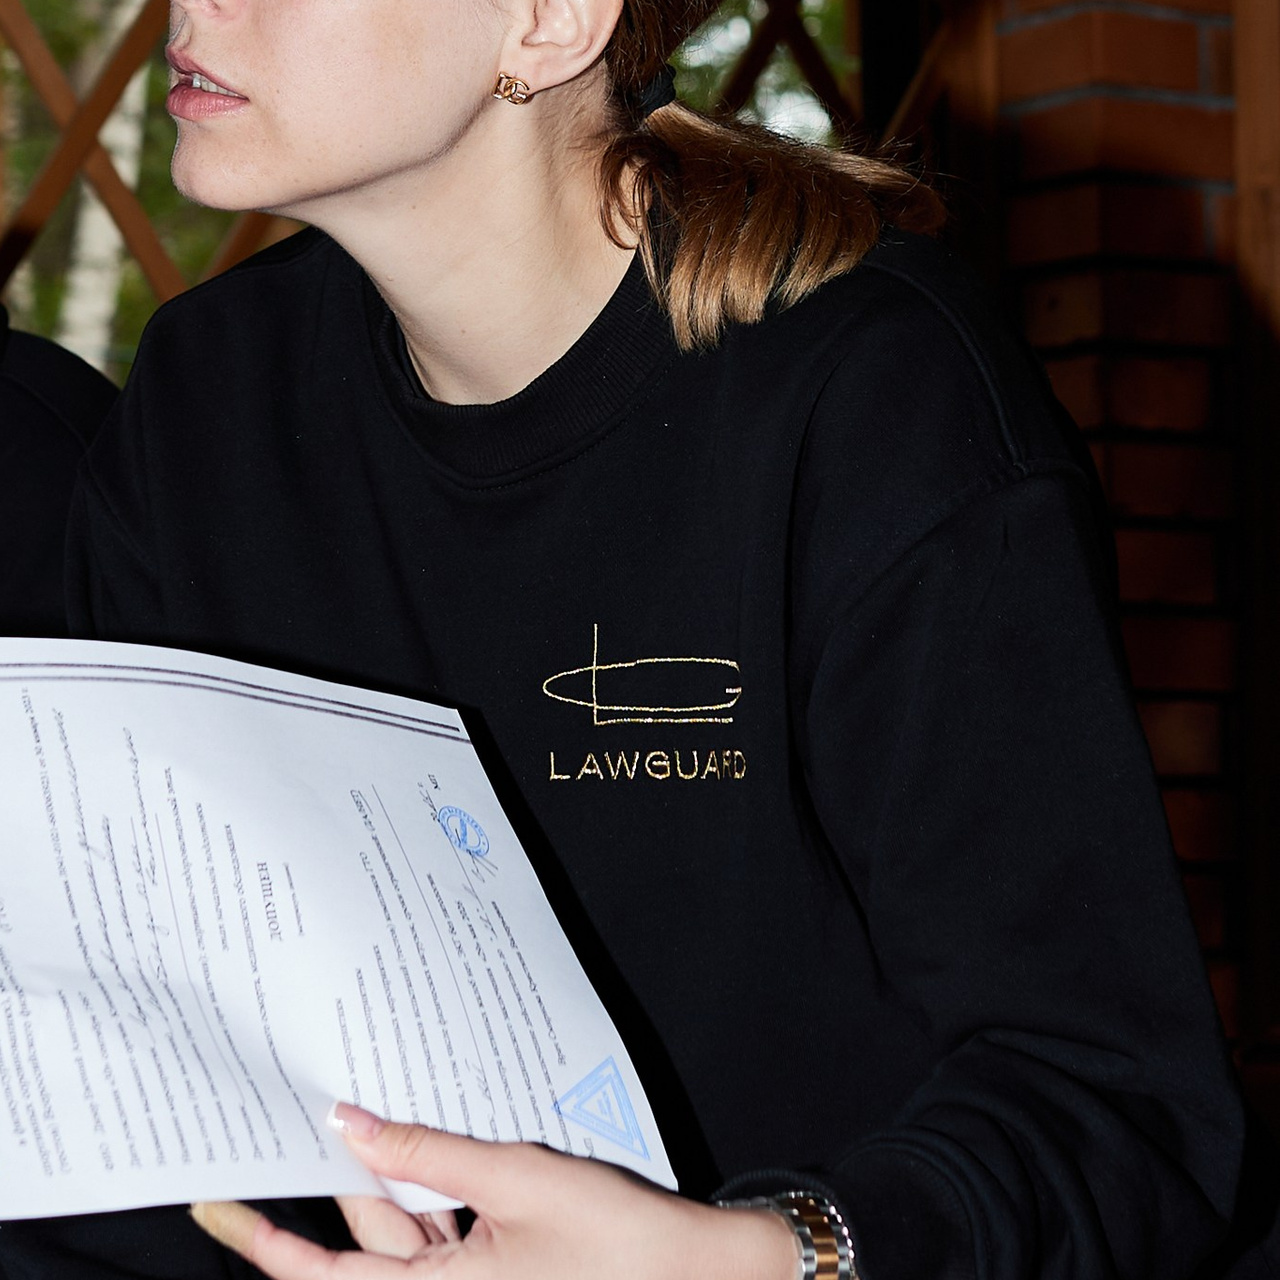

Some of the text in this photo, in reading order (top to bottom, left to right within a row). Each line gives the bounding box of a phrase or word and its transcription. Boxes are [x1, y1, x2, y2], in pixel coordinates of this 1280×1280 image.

[549, 748, 747, 781] LAWGUARD
[195, 802, 212, 862] подготовки
[224, 823, 244, 894] обследования
[358, 851, 373, 872] ГТО
[205, 865, 223, 920] начальной
[256, 861, 281, 940] ДОПУЩЕН
[369, 873, 391, 921] комплекса
[238, 897, 258, 973] медицинского
[386, 923, 405, 962] (тестов)
[446, 920, 457, 935] без
[450, 936, 466, 957] ЭКГ
[467, 923, 477, 939] мая
[372, 944, 395, 1013] мероприятиях
[399, 964, 420, 1018] испытаний
[424, 969, 446, 1025] физических
[467, 979, 484, 1008] жалоб
[485, 967, 509, 1020] заключения
[502, 961, 532, 1026] действительно
[515, 950, 537, 992] Кристина
[355, 967, 376, 1041] мероприятиям
[391, 1017, 415, 1097] физкультурных
[416, 1021, 436, 1081] нормативов
[480, 1011, 500, 1056] активных
[506, 1023, 532, 1091] медицинского
[528, 1029, 552, 1086] заключение
[23, 1021, 54, 1119] Всероссийского
